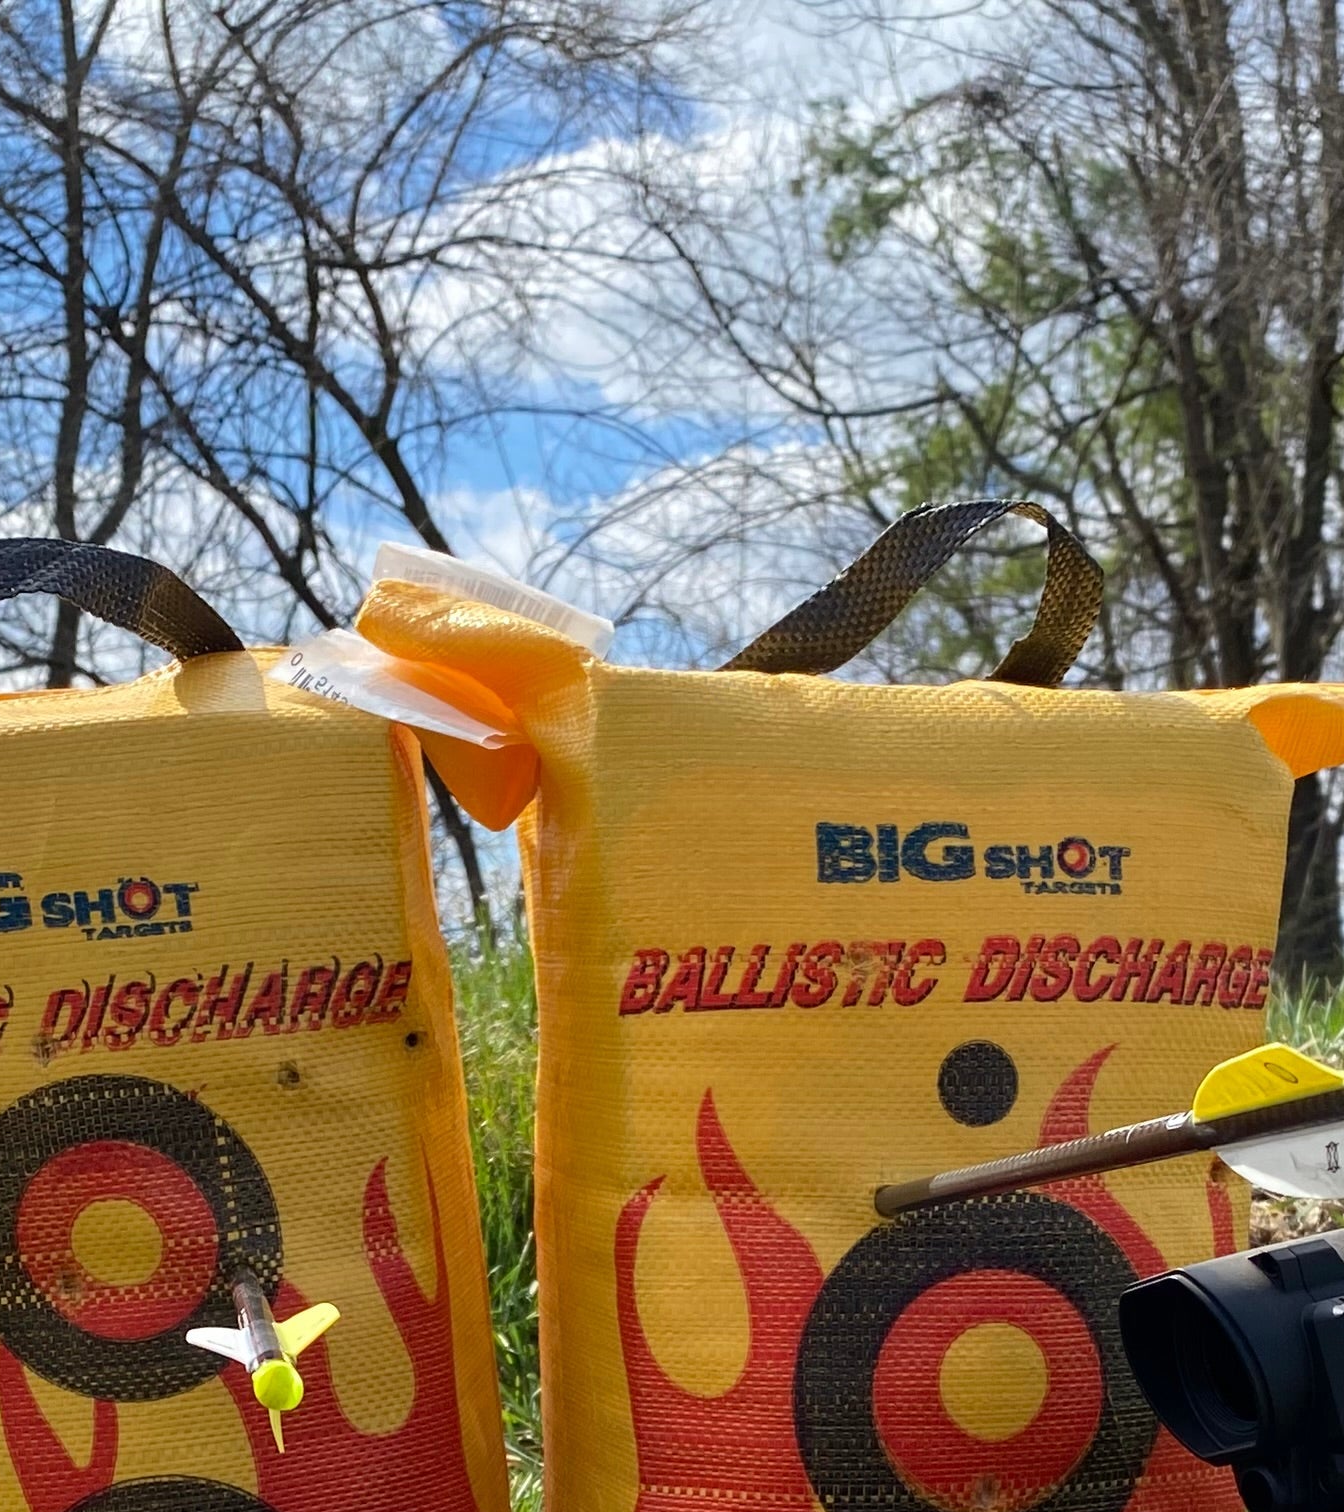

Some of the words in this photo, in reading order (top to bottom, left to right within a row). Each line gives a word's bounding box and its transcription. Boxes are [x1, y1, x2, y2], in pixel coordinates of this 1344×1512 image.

[816, 821, 976, 884] BIG
[984, 836, 1131, 881] SHOT
[42, 876, 201, 929] SHOT
[1021, 880, 1123, 896] TARGETS
[83, 921, 193, 942] TARGETS
[41, 954, 413, 1049] DISCHARGE
[618, 938, 948, 1017] BALLISTIC
[963, 933, 1274, 1010] DISCHARGE
